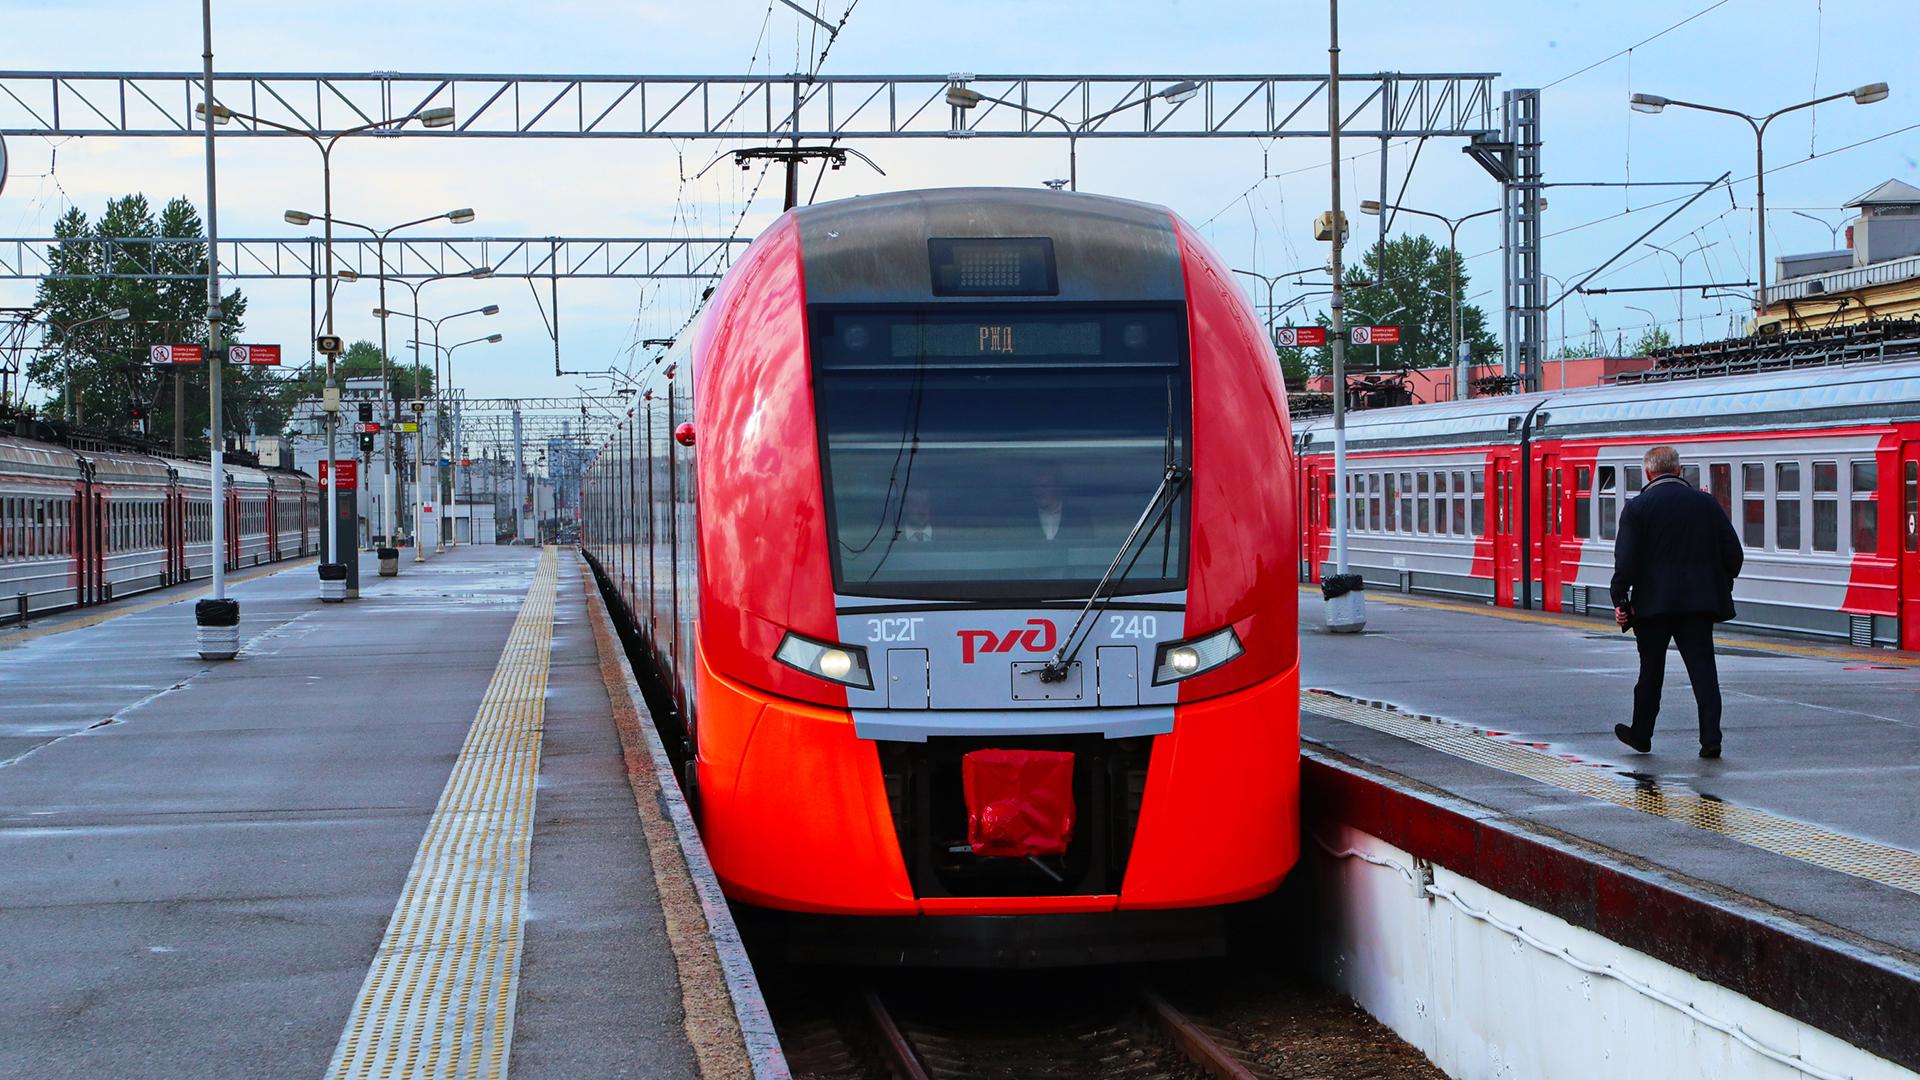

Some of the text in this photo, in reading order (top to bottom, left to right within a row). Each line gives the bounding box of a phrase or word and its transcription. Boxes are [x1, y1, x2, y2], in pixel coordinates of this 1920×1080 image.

[979, 326, 1013, 353] РЖД
[867, 617, 924, 642] ЭС2Г
[1110, 615, 1157, 639] 240
